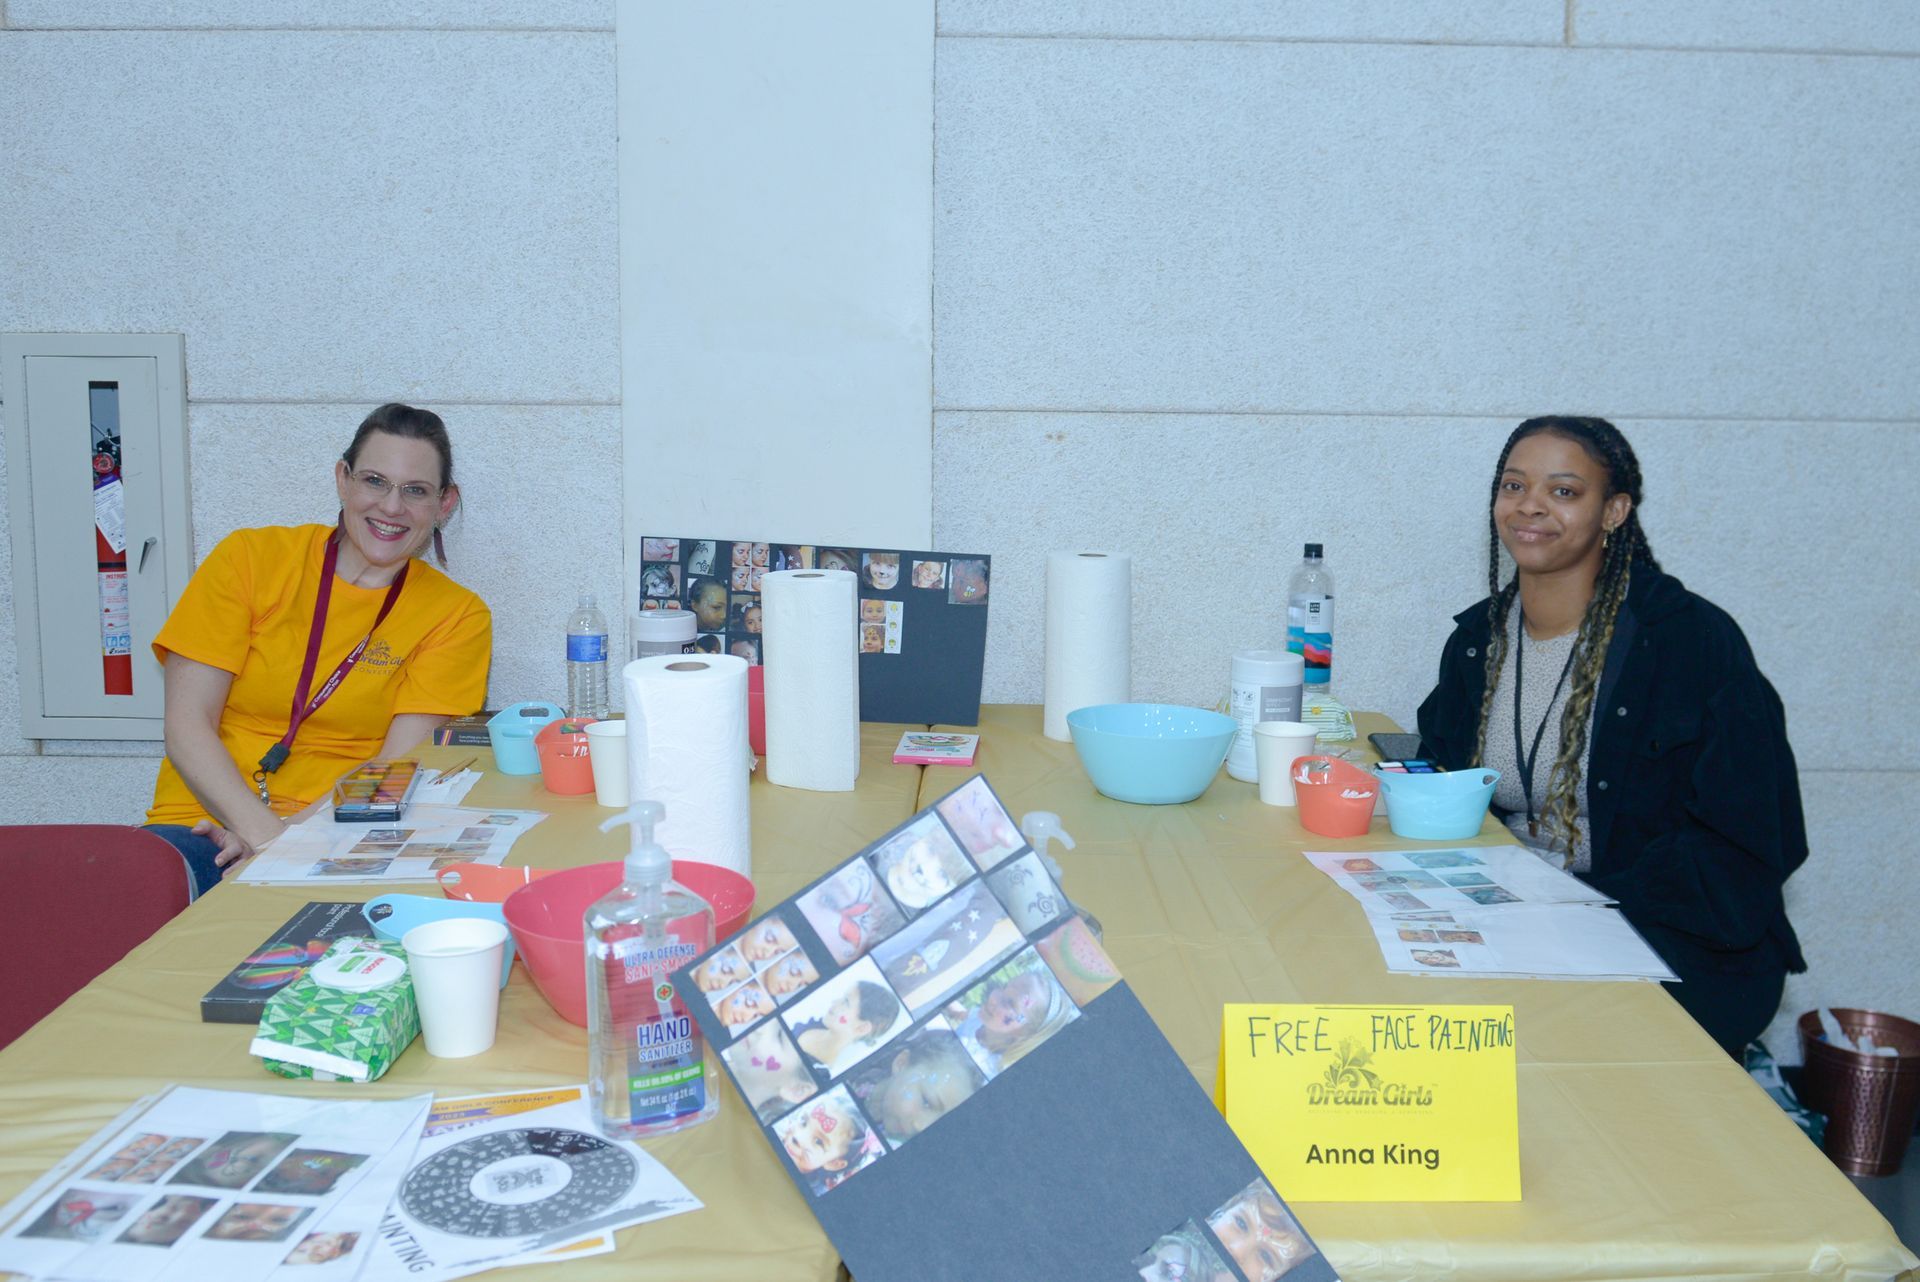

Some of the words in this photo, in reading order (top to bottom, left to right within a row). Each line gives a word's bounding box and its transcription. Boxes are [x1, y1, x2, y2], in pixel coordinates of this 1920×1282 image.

[624, 951, 654, 967] ULTRA
[657, 944, 695, 959] DEFENSE
[639, 1017, 689, 1046] HAND
[1248, 1016, 1332, 1057] FREE
[1371, 1014, 1419, 1052] FACE
[1428, 1013, 1513, 1052] PAINTING
[640, 1040, 692, 1061] SANITIZER
[1307, 1082, 1378, 1106] Dream
[1383, 1082, 1433, 1106] Girls
[1306, 1144, 1375, 1165] Anna
[1383, 1143, 1440, 1170] King
[378, 1206, 435, 1274] AINTING
